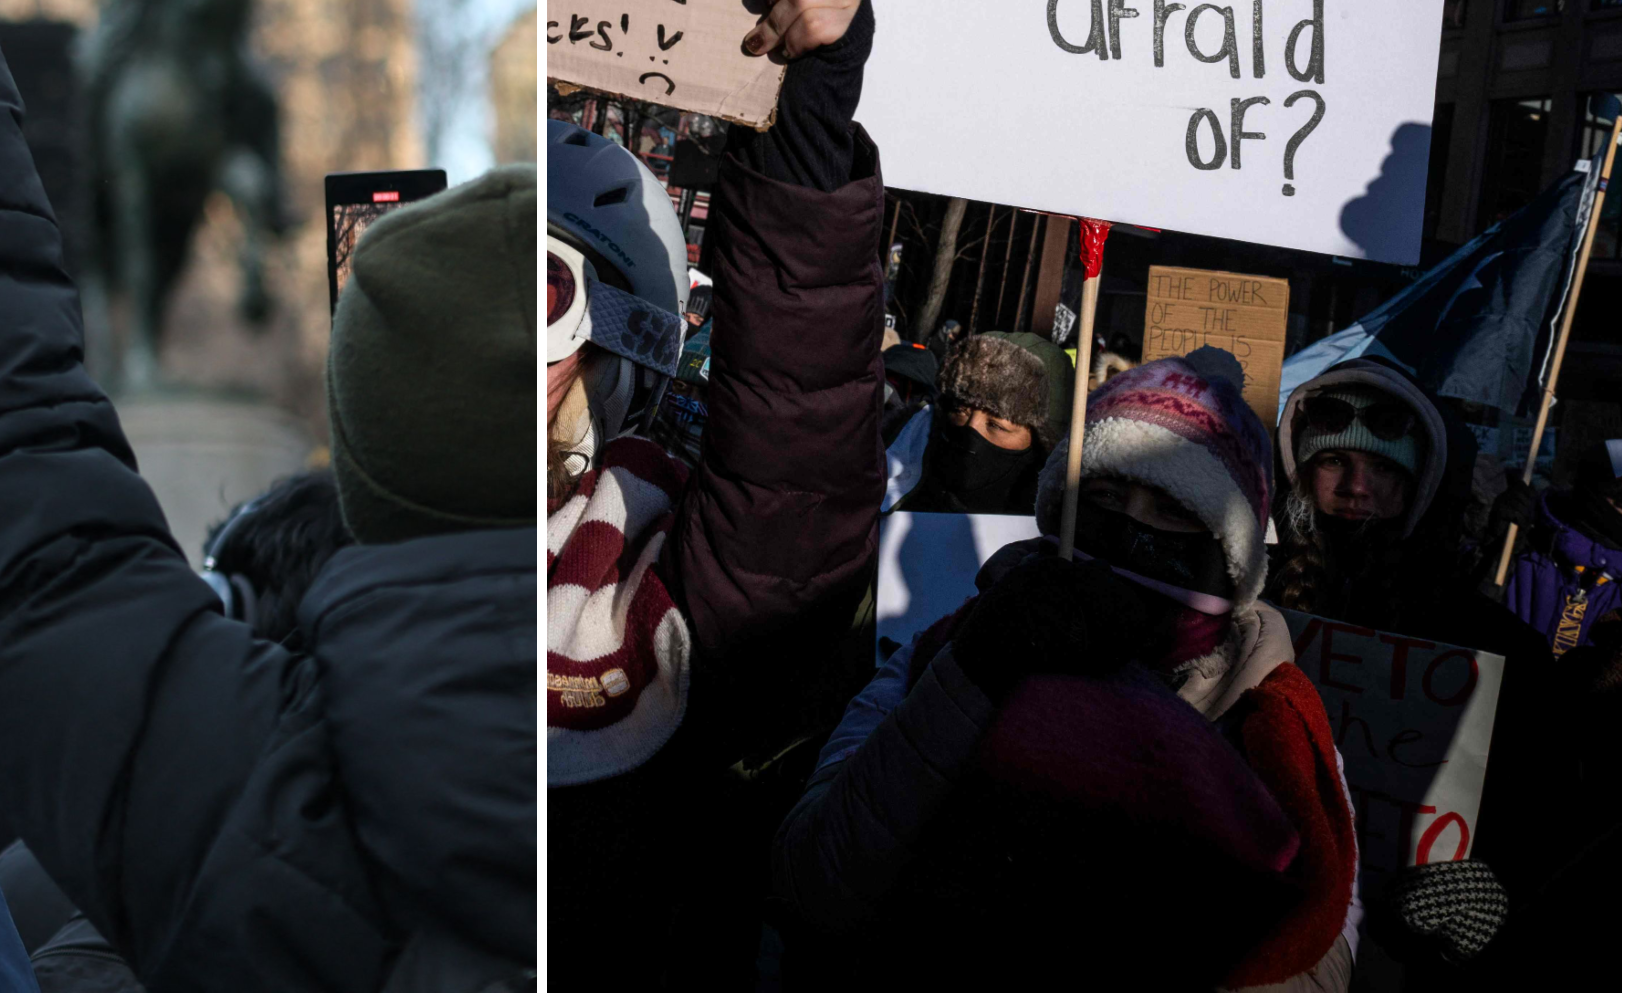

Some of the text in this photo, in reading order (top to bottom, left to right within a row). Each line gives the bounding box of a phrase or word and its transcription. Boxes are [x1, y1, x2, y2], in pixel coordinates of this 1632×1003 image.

[563, 212, 636, 268] CRATONI
[1152, 275, 1267, 305] THE POWER
[1151, 302, 1237, 332] OF THE
[1231, 334, 1252, 358] IS
[1328, 700, 1448, 768] he
